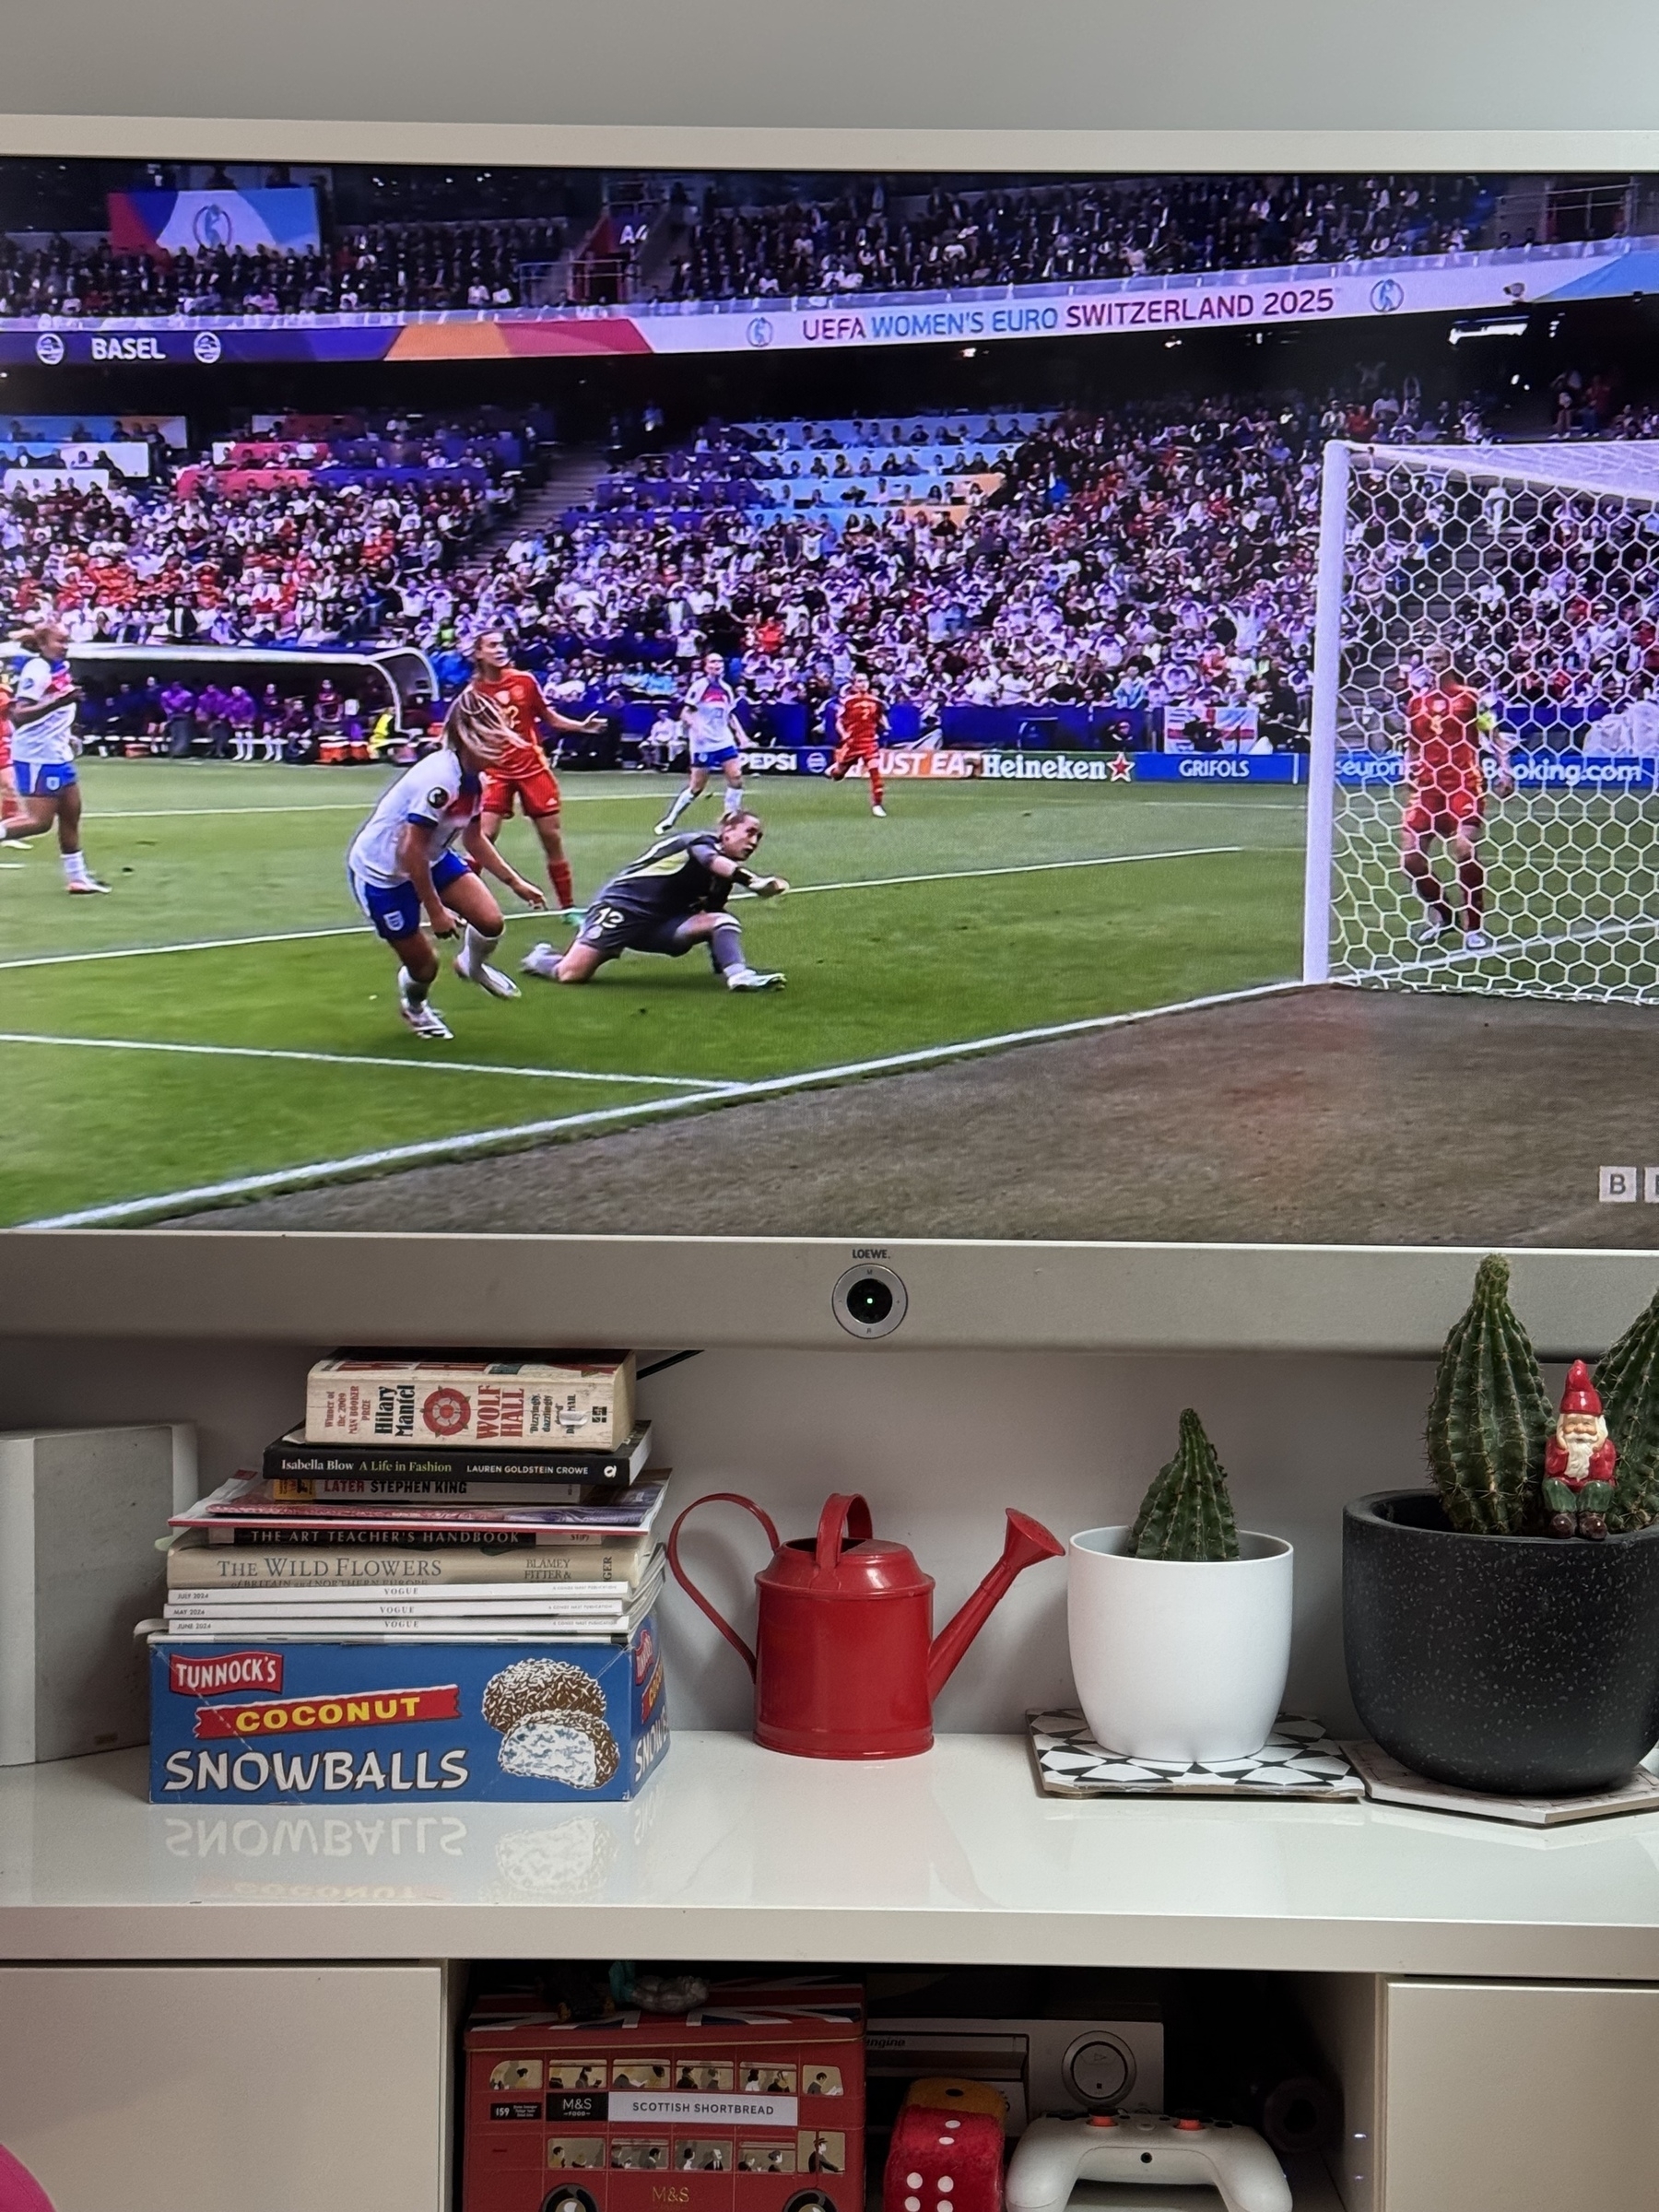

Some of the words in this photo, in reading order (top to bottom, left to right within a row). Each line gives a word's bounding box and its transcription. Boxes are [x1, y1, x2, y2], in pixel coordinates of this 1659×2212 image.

[803, 317, 866, 341] UEFA
[872, 312, 983, 338] WOMEN'S
[992, 308, 1058, 333] EURO
[1065, 294, 1254, 328] SWITZERLAND
[1263, 288, 1335, 316] 2025
[92, 337, 166, 359] BASEL
[738, 752, 797, 771] PEPSI
[877, 753, 928, 776] UST
[982, 754, 1108, 779] Heineken
[1178, 759, 1250, 777] GRIFOLS
[1482, 758, 1641, 785] Boking.com
[338, 1393, 347, 1415] 2009
[349, 1385, 359, 1417] BOOKER
[361, 1399, 371, 1420] PRIZE
[374, 1386, 397, 1434] Hilary
[394, 1384, 416, 1437] Mantel
[477, 1385, 501, 1439] WOLF
[500, 1388, 524, 1438] HALL
[281, 1458, 324, 1471] Isabella
[327, 1459, 355, 1471] Blow
[359, 1461, 368, 1472] A
[371, 1460, 394, 1472] Life
[395, 1461, 406, 1472] in
[409, 1461, 453, 1473] Fashion
[466, 1465, 502, 1474] LAUREN
[504, 1465, 554, 1475] GOLDSTEIN
[556, 1466, 589, 1476] CROWE
[324, 1479, 365, 1493] LATER
[371, 1479, 431, 1494] STEPHEN
[435, 1480, 467, 1494] KING
[251, 1530, 281, 1542] THE
[288, 1530, 320, 1542] ART
[327, 1530, 416, 1543] TEACHER'S
[423, 1531, 520, 1544] HANDBOOK
[218, 1560, 258, 1577] THE
[264, 1558, 329, 1577] WILD
[336, 1557, 441, 1577] FLOWERS
[526, 1559, 571, 1569] BLAMEY
[244, 1580, 291, 1588] BRITAIN
[524, 1570, 562, 1581] FITTER
[563, 1571, 571, 1580] &
[384, 1620, 419, 1629] VOGUE
[175, 1655, 276, 1688] TUNNOCK'S
[236, 1697, 421, 1732] COCONUT
[161, 1748, 470, 1792] SNOWBALLS
[496, 2107, 510, 2117] 159
[562, 2098, 592, 2111] M&S
[632, 2101, 690, 2112] SCOTTISH
[694, 2103, 774, 2115] SHORTBREAD
[652, 2186, 689, 2203] M&S
